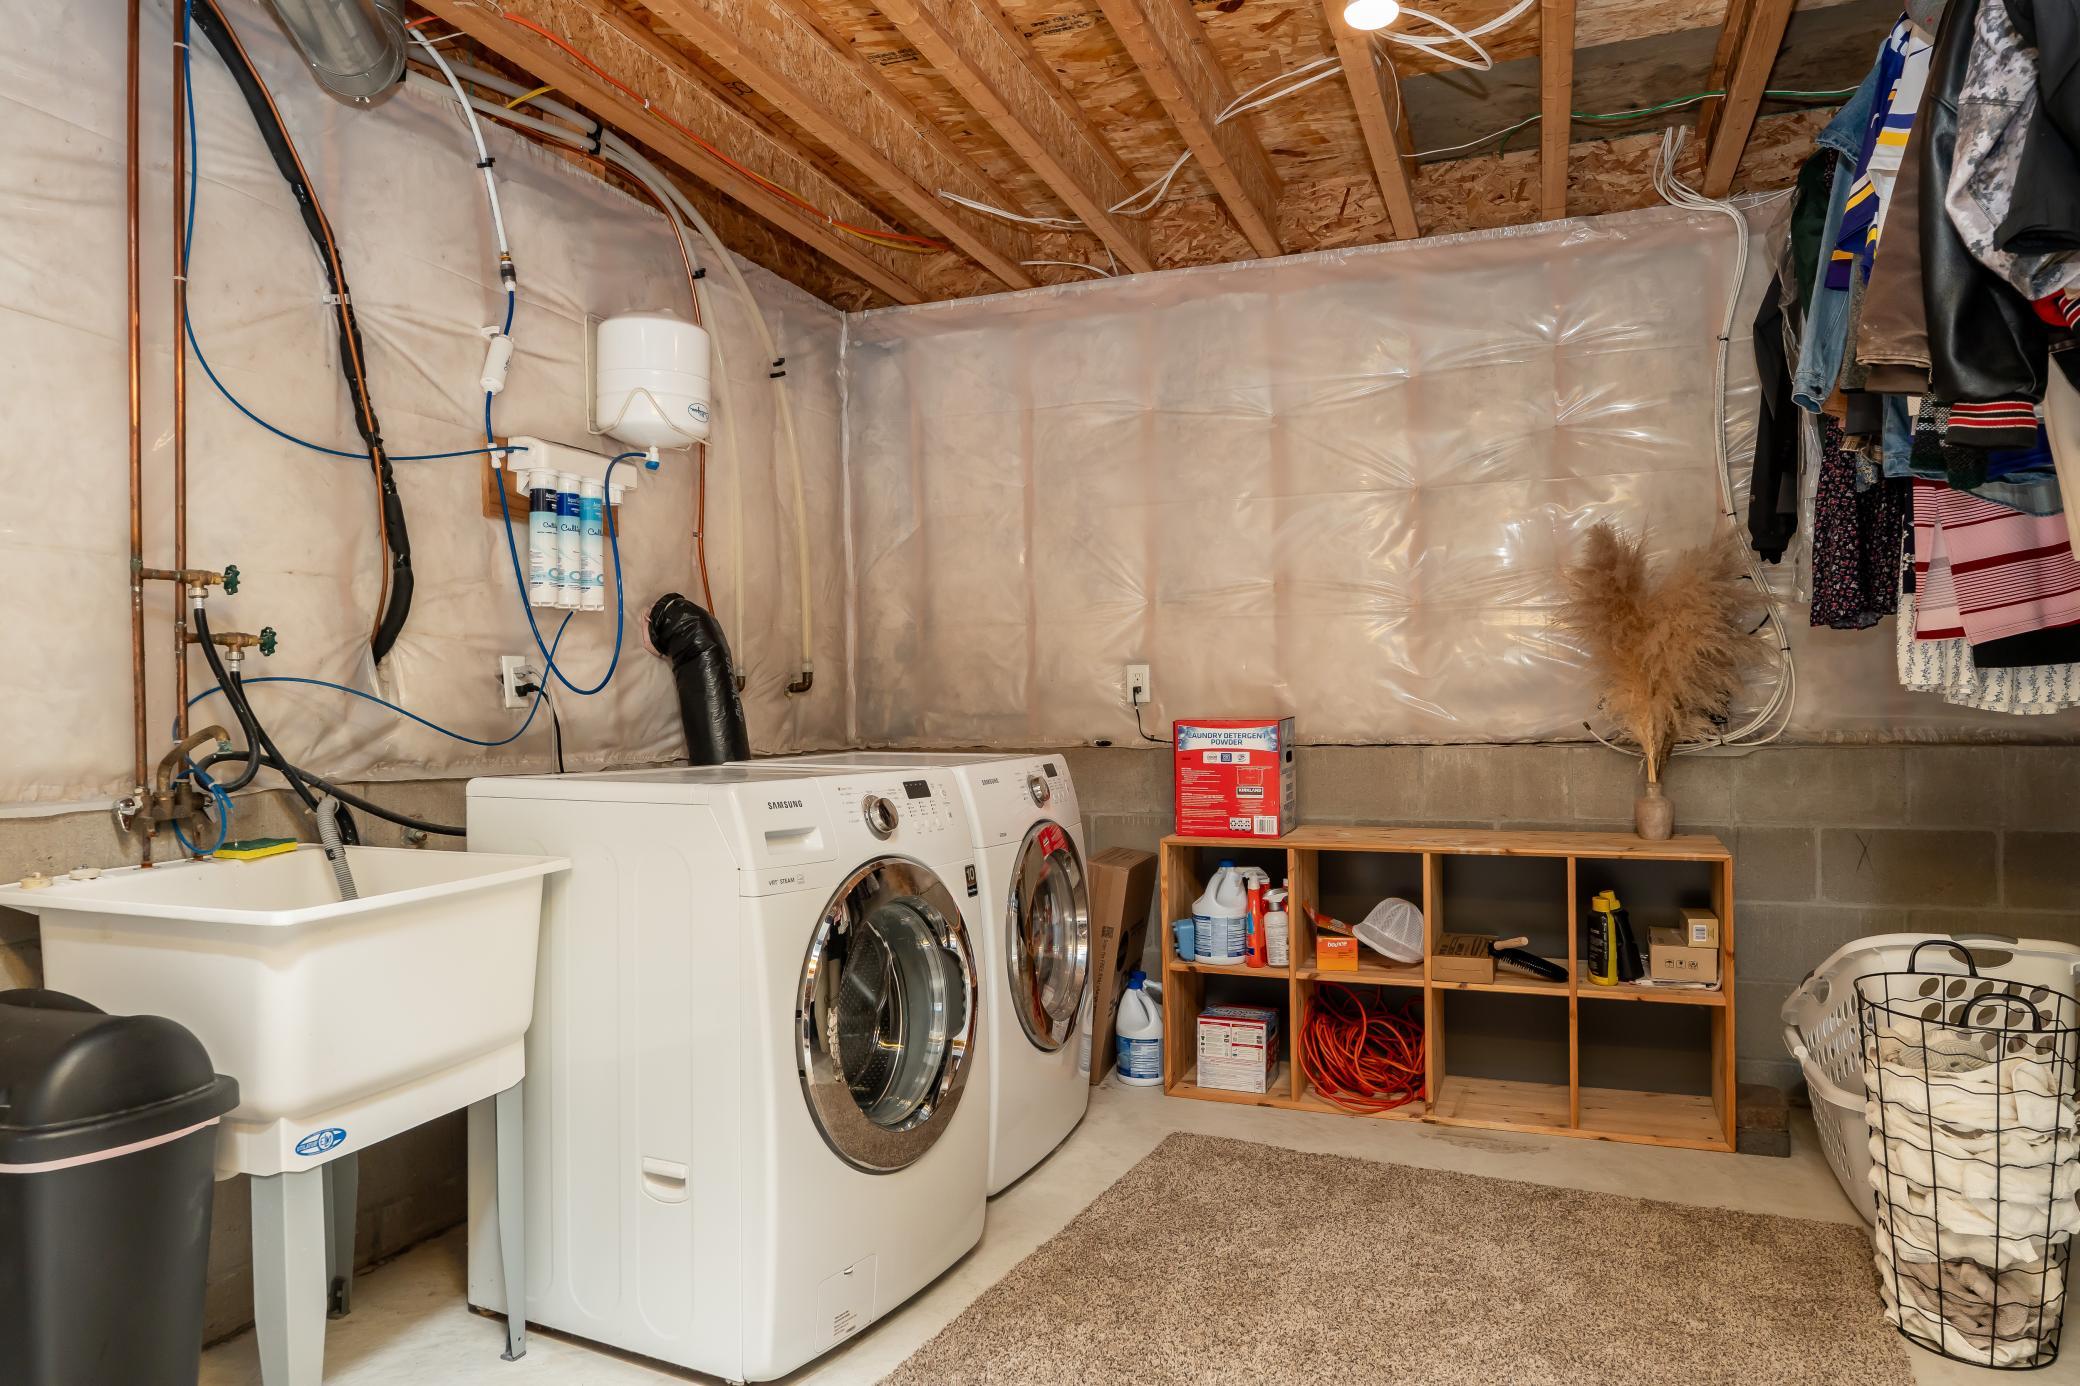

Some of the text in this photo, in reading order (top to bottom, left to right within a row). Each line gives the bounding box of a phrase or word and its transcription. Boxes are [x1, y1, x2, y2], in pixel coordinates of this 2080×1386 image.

[767, 799, 803, 810] SAMSUNG
[966, 867, 975, 881] 10
[779, 877, 795, 885] STEAM
